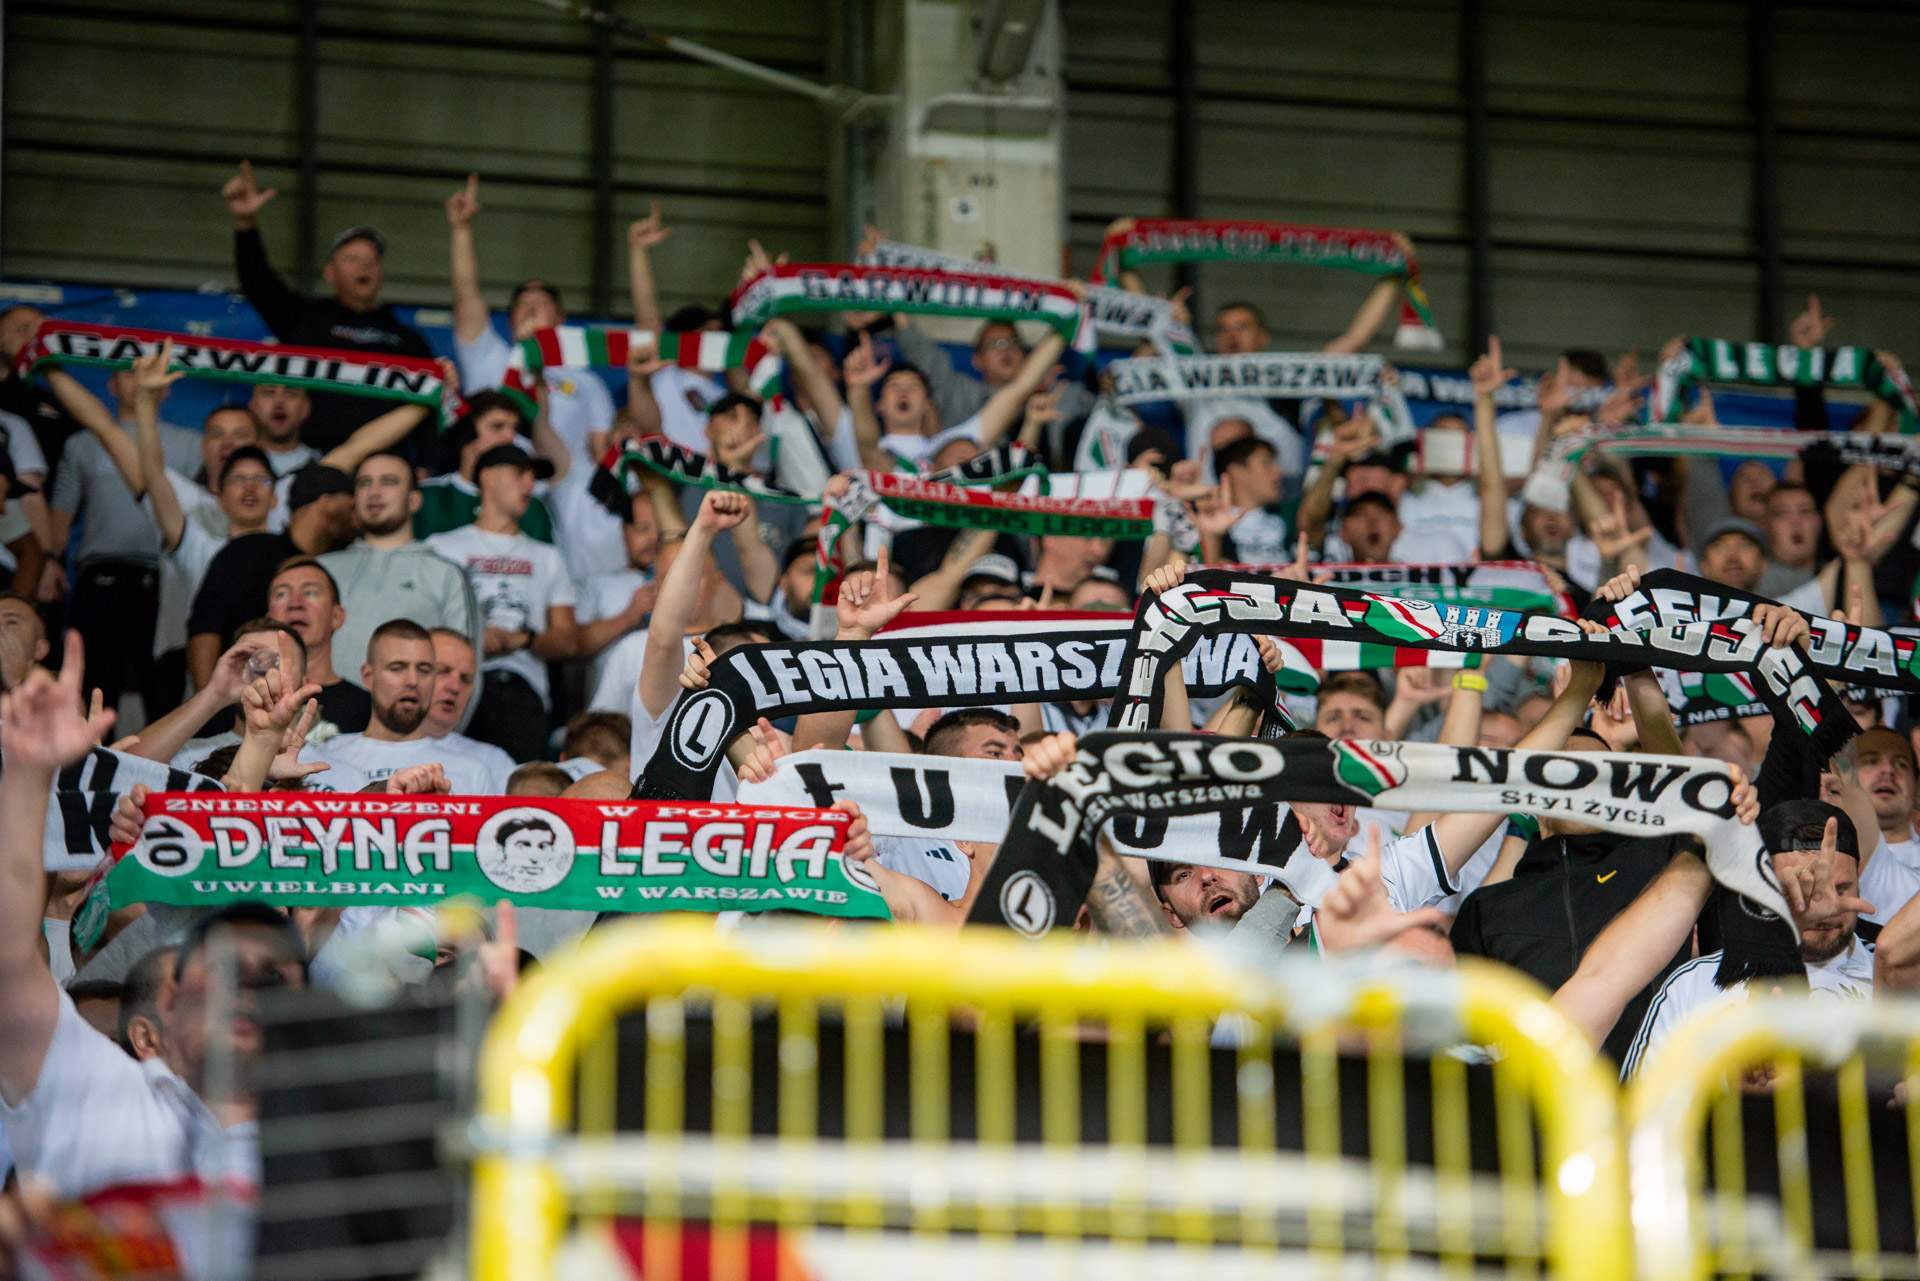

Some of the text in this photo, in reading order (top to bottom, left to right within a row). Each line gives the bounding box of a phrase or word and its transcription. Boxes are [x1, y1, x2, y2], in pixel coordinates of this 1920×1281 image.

[803, 269, 1043, 312] GARWOLIN
[55, 331, 432, 392] GARWOLIN
[1715, 338, 1858, 384] LEGIA
[733, 632, 1260, 711] LEGIA WARSZWA
[1028, 741, 1285, 856] LEGIO
[1451, 746, 1735, 820] NOWO
[1500, 789, 1576, 811] Styl
[165, 798, 849, 823] ZNIENAWIDZENI W POLSCE
[144, 820, 188, 868] 10
[208, 815, 836, 884] DEYNA LEGIA
[191, 880, 849, 905] UWIELBIANI W WARSZAWIE
